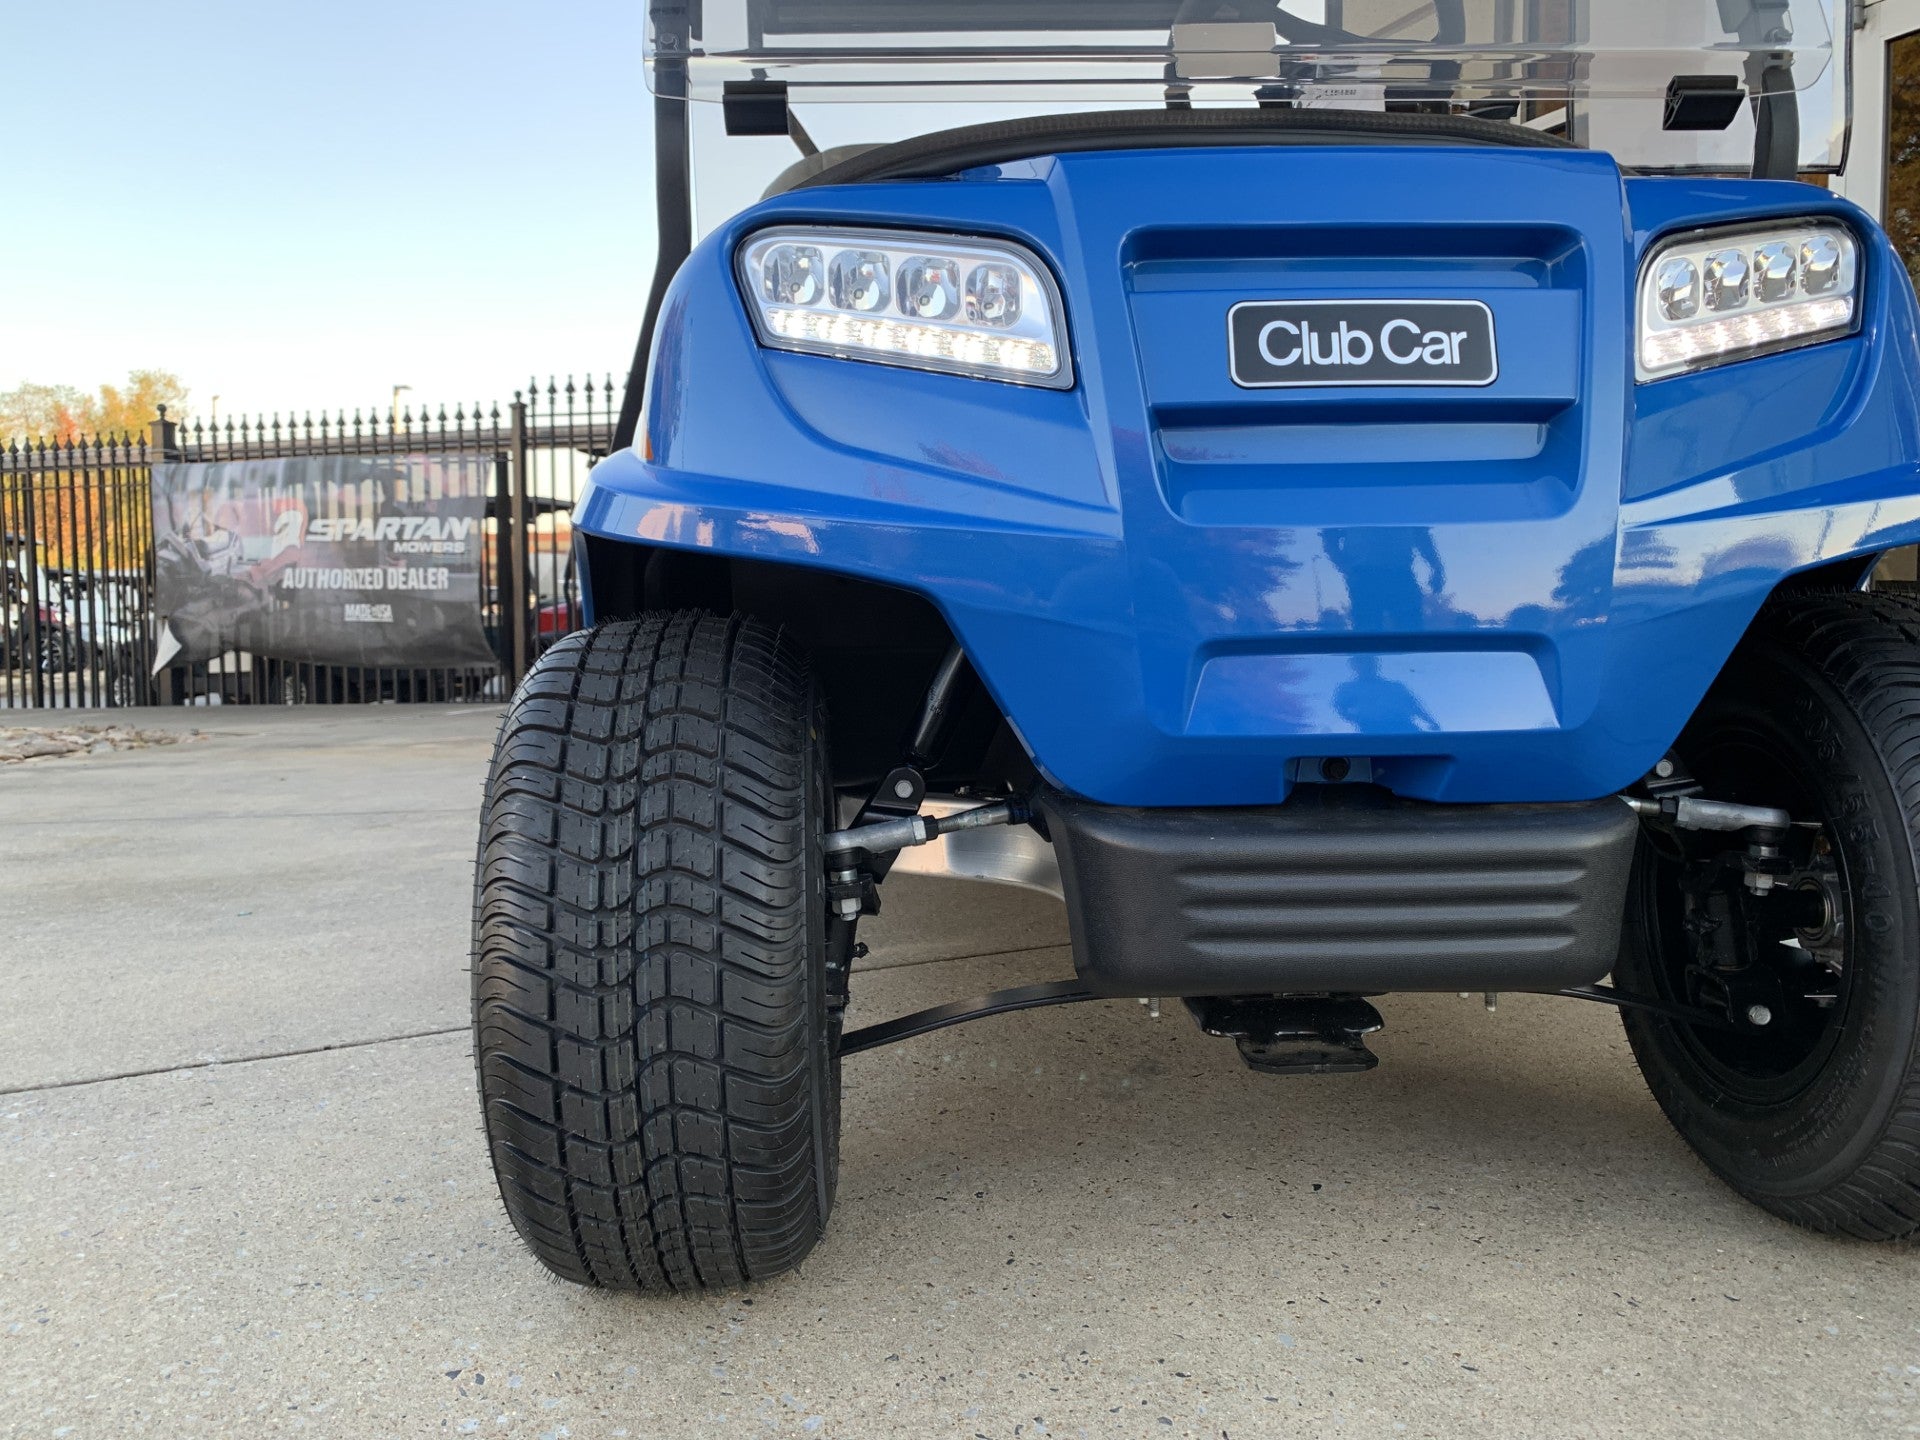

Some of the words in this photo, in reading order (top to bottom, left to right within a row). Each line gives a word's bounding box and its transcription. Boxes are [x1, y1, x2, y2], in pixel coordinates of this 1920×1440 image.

[1258, 319, 1374, 366] Club
[1380, 318, 1467, 365] Car
[305, 516, 471, 542] SPARTAN
[393, 541, 465, 553] MOWERS
[282, 567, 384, 590] AUTHORIZED
[387, 567, 449, 590] DEALER
